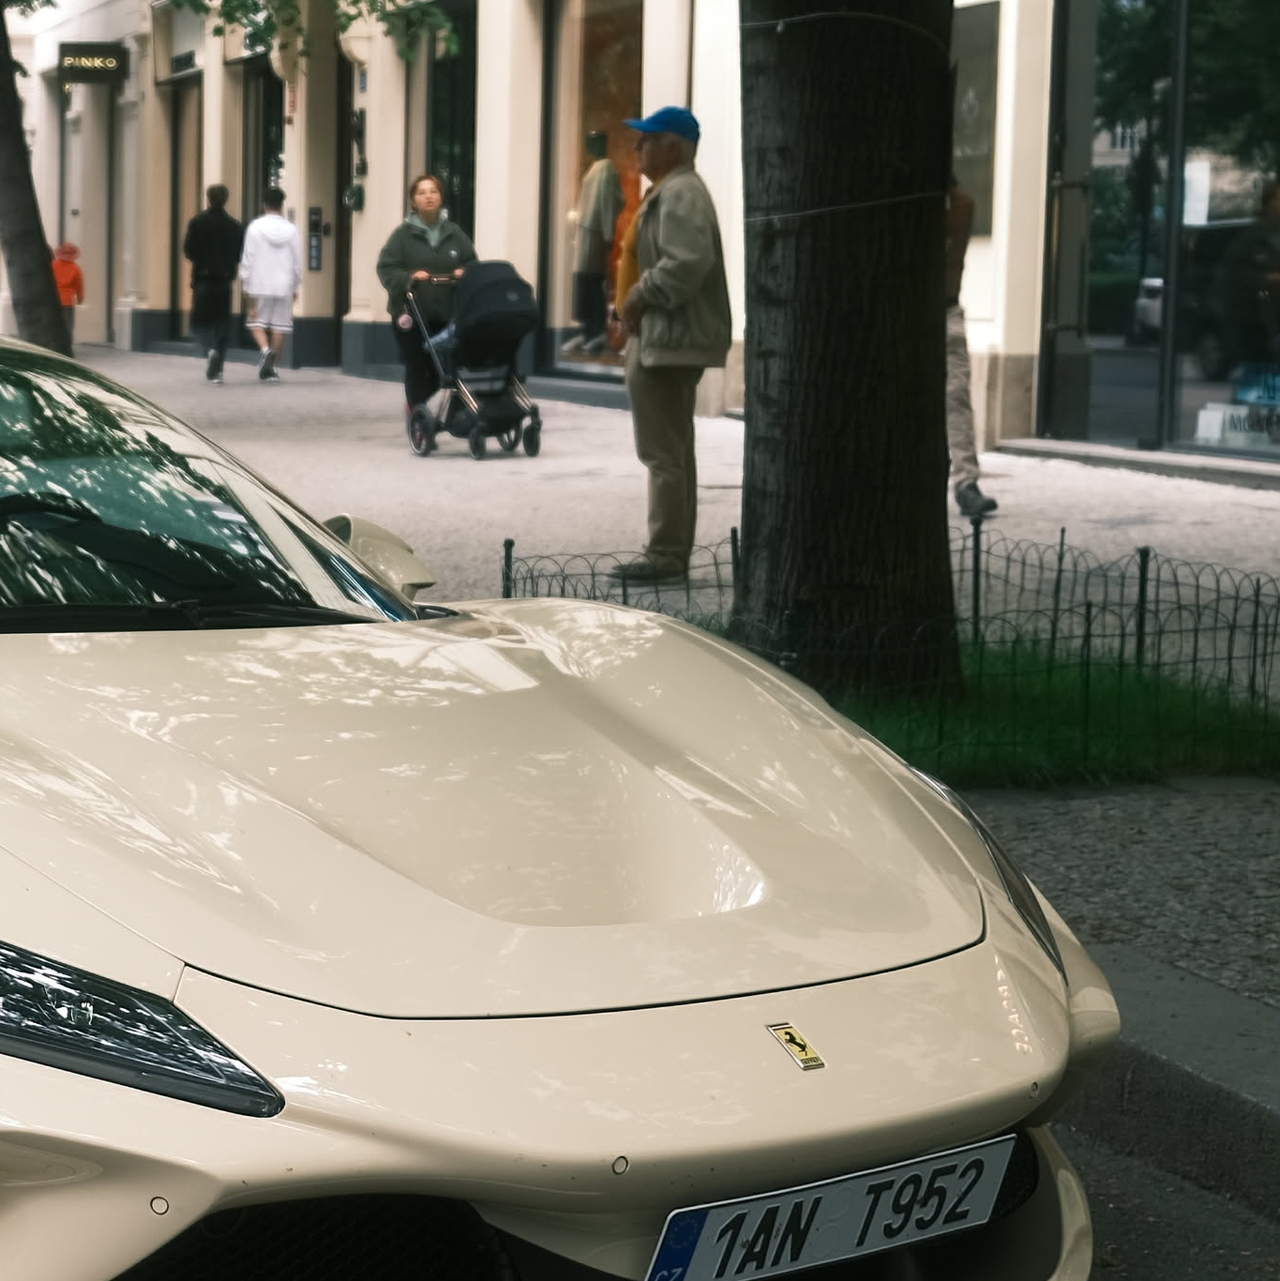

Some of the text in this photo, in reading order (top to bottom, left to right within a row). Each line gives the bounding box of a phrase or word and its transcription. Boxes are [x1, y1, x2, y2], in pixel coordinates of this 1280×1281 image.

[63, 56, 117, 68] PINKO
[714, 1157, 985, 1279] 1AN T952
